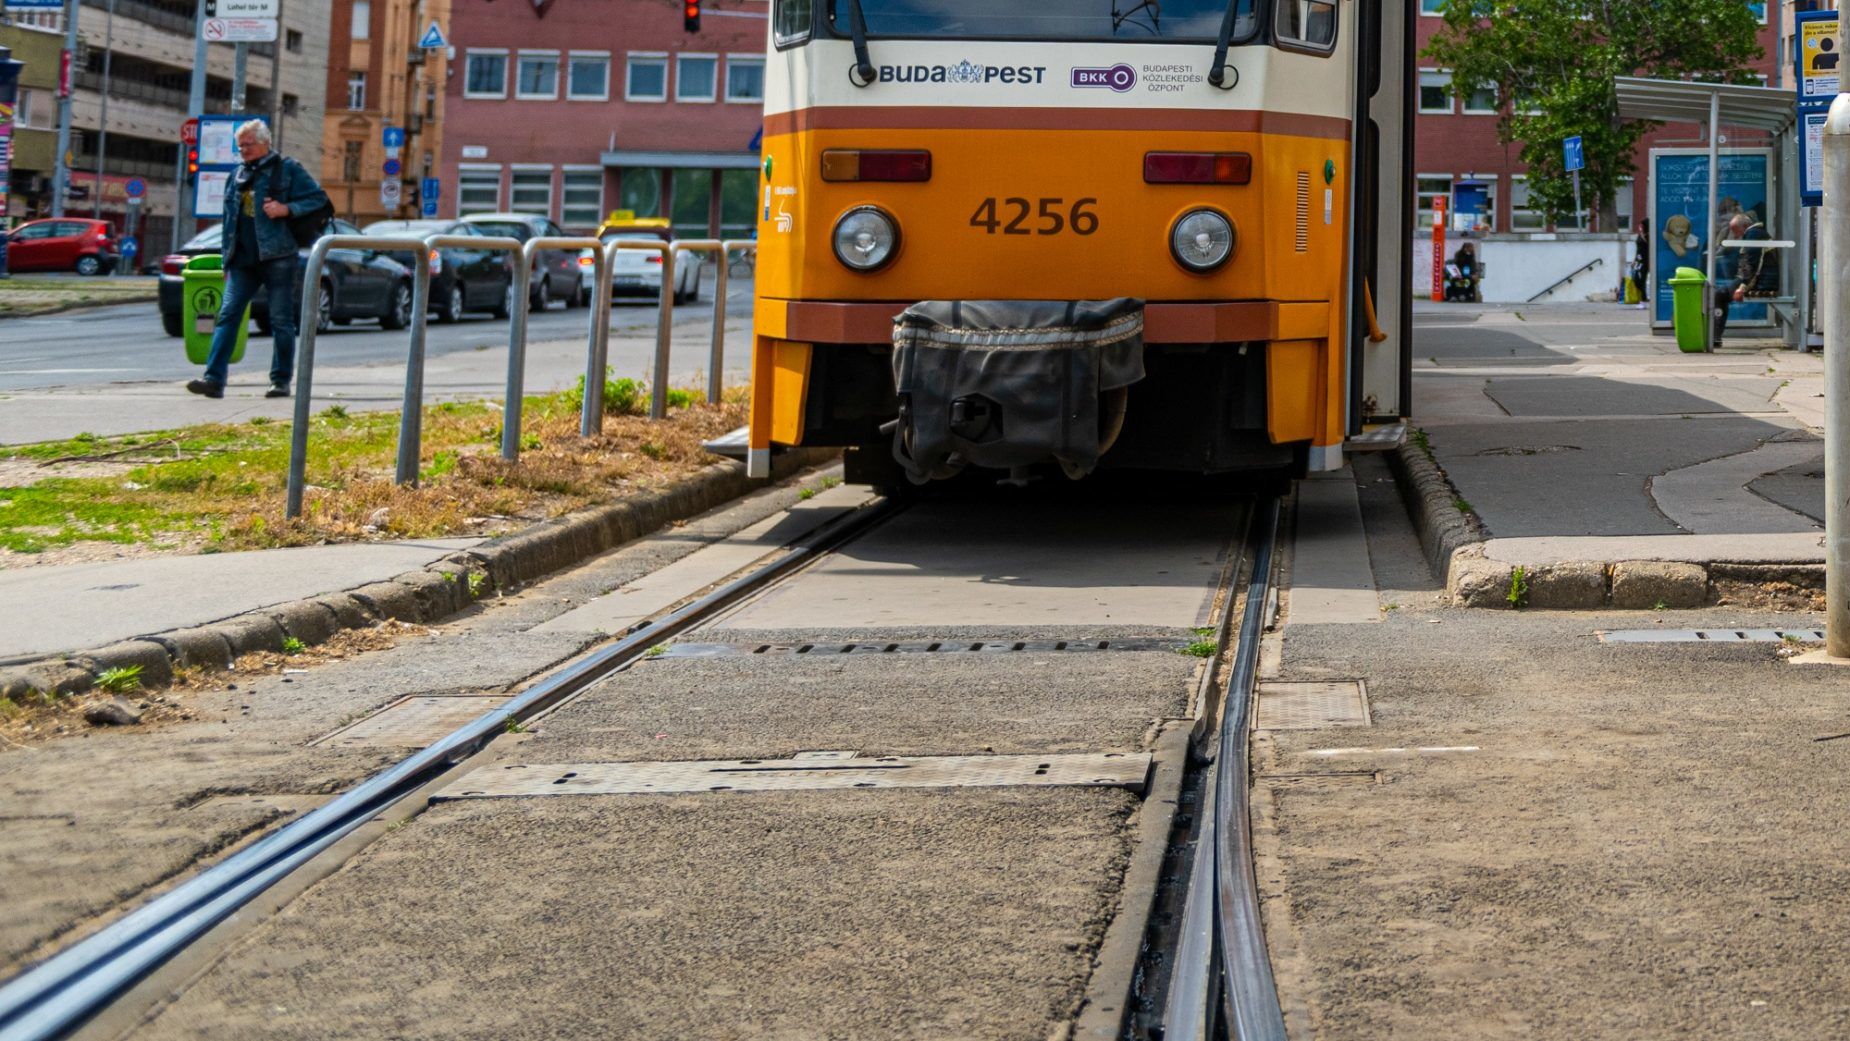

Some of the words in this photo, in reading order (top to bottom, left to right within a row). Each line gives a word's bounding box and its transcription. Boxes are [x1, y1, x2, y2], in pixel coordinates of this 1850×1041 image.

[1143, 64, 1193, 73] BUDAPESTI
[1080, 72, 1107, 83] BKK
[1143, 73, 1204, 83] KÖZLEKEDÉSI
[970, 197, 1099, 236] 4256
